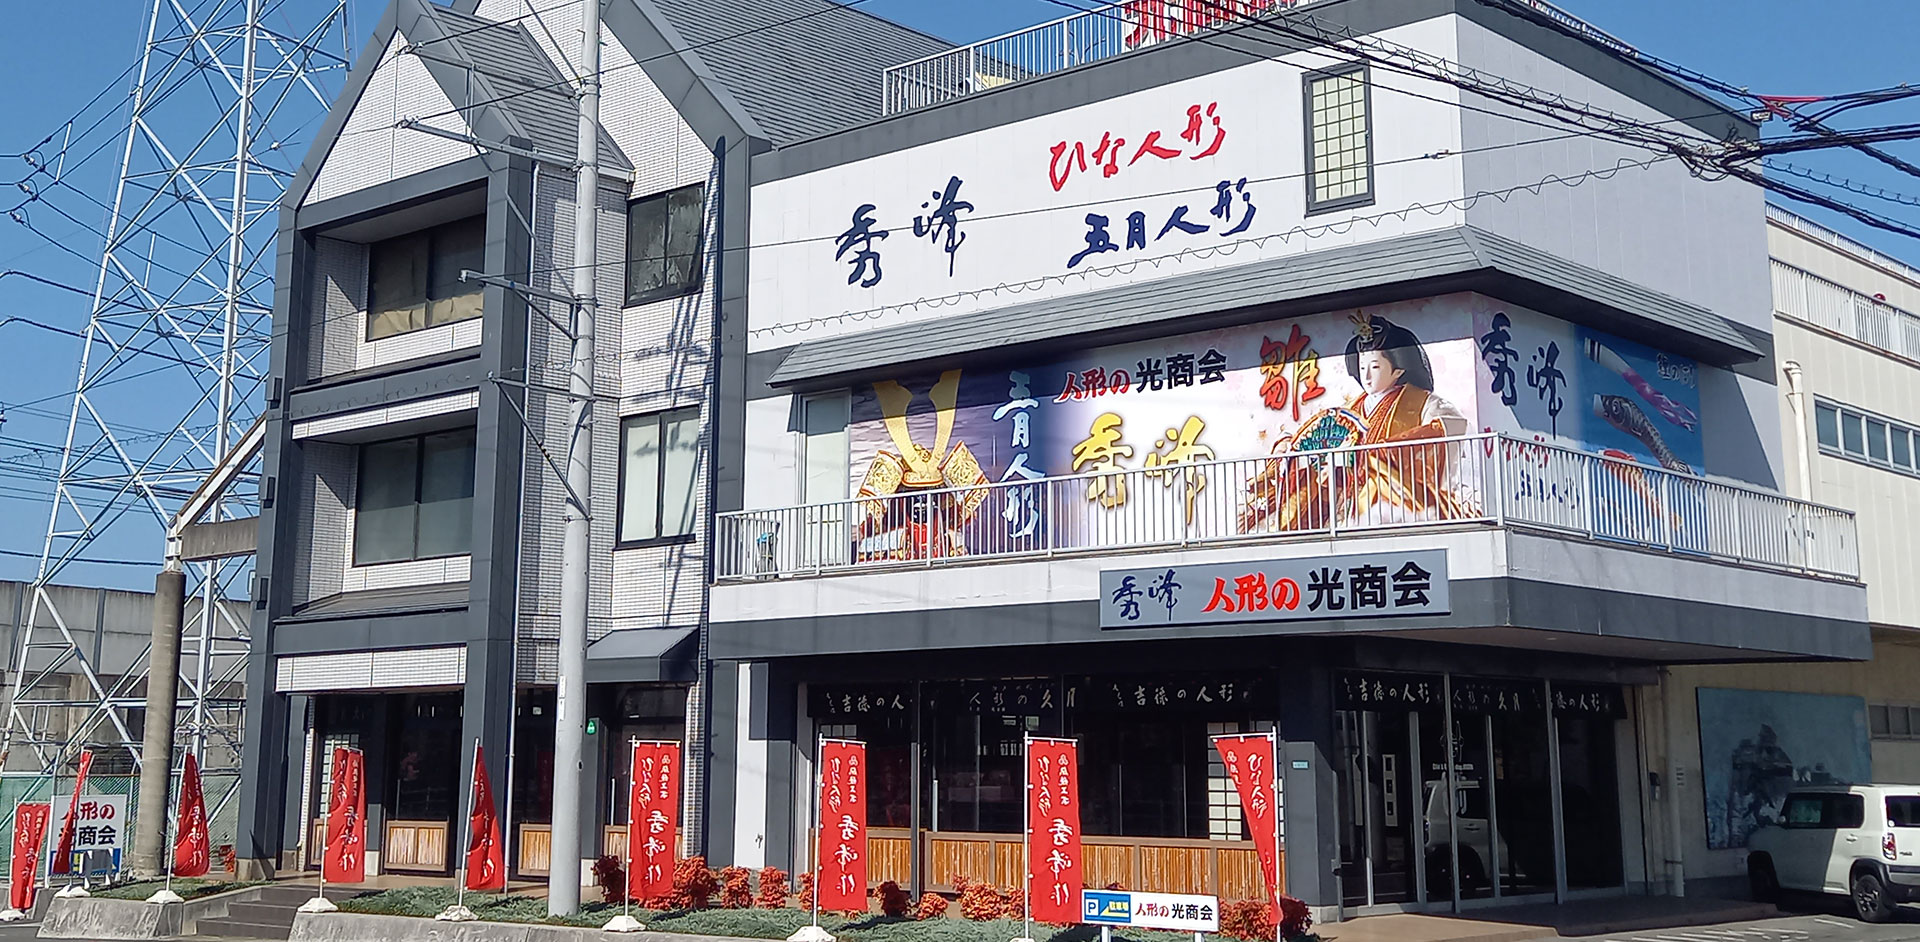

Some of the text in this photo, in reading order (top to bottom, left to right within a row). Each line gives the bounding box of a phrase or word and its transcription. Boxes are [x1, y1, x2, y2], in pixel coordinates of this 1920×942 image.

[1049, 101, 1227, 191] ひな人形
[1067, 177, 1257, 268] 五月人形
[1259, 324, 1327, 421] 雛
[1200, 561, 1432, 613] 人形の光商会
[59, 824, 117, 847] 商会
[1087, 901, 1097, 913] P
[1135, 902, 1213, 921] 人形の光商会
